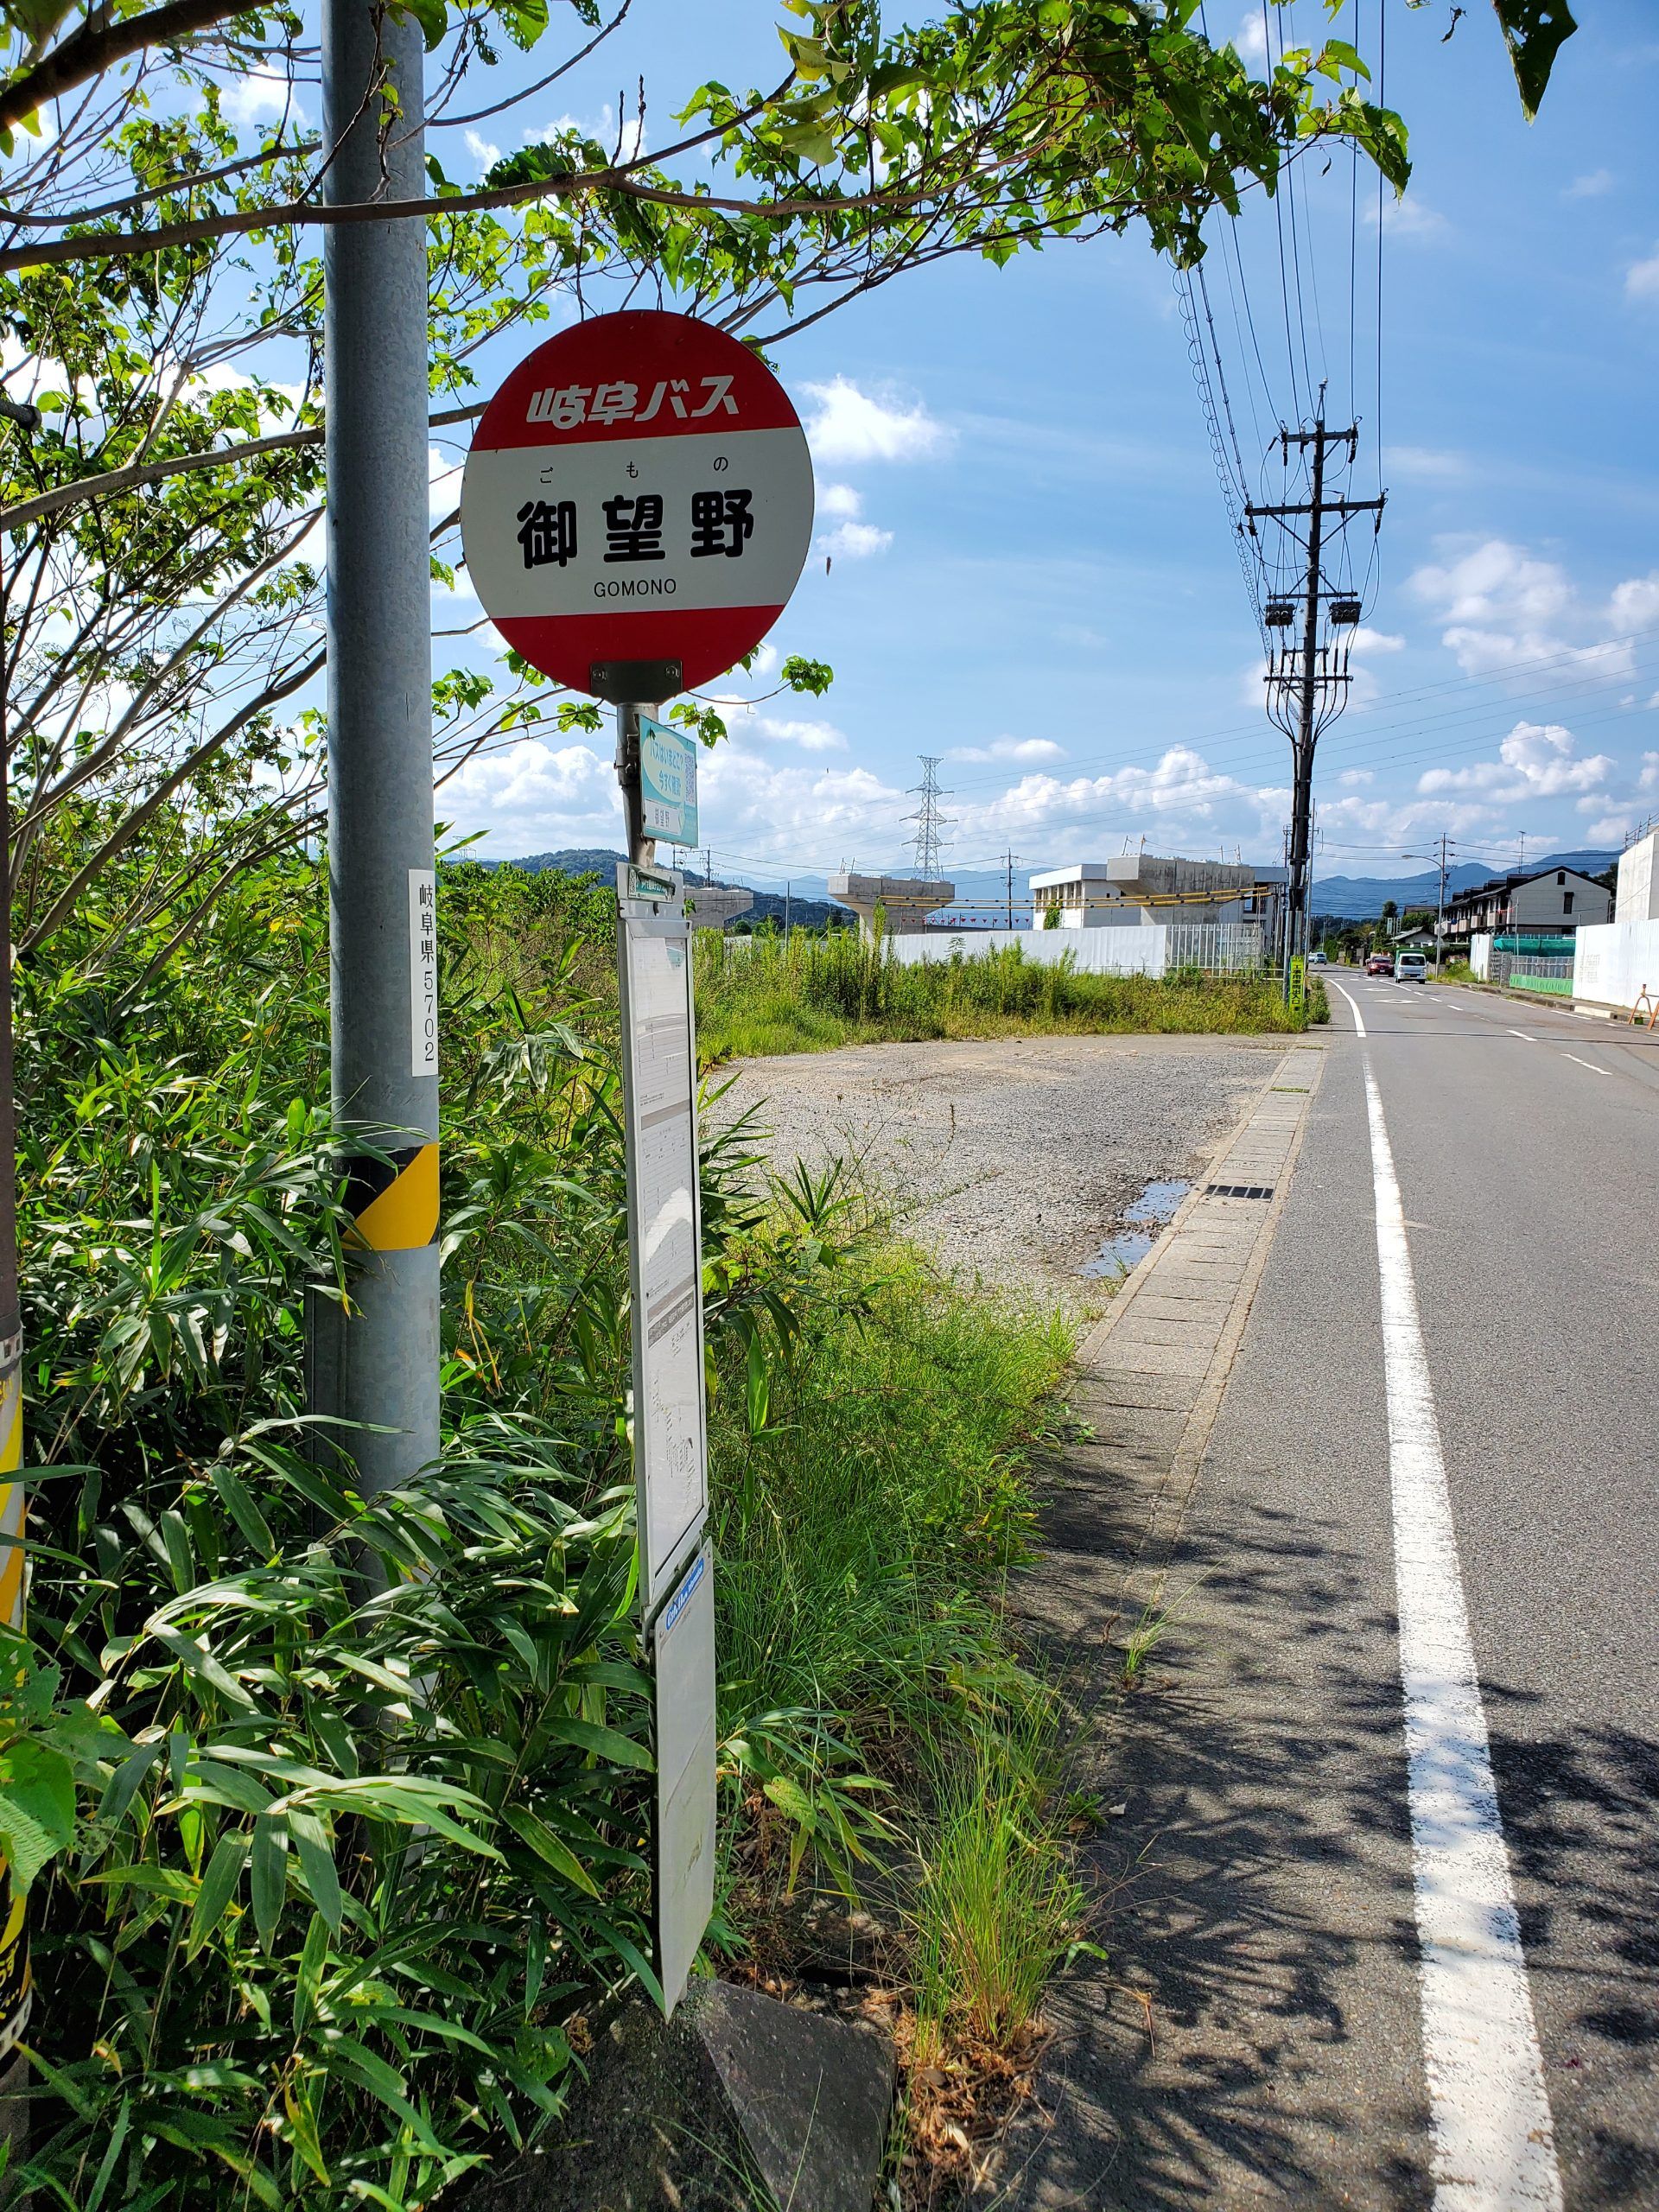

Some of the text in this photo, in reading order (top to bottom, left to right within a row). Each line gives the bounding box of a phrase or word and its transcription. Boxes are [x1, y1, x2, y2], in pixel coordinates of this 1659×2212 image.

[525, 374, 740, 429] 岐阜バス
[540, 455, 729, 484] ごもの
[516, 488, 754, 569] 御望野
[593, 578, 677, 598] GOMONO
